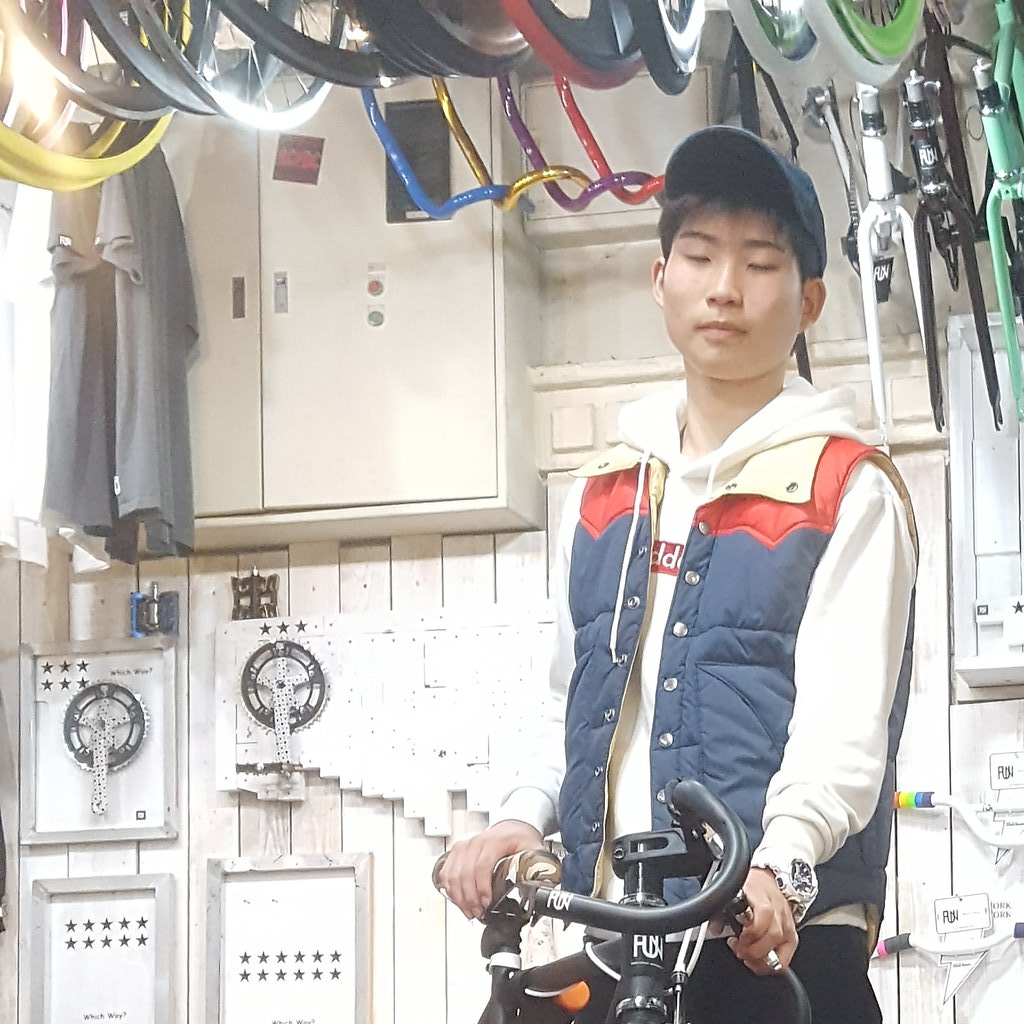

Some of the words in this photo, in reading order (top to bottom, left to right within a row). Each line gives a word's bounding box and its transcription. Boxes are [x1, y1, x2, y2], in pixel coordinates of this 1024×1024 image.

[997, 765, 1014, 780] FUN
[546, 889, 575, 911] FUN
[942, 909, 959, 924] FUN
[992, 911, 1012, 919] ORK
[633, 934, 664, 961] FUN
[107, 1012, 127, 1020] Way?
